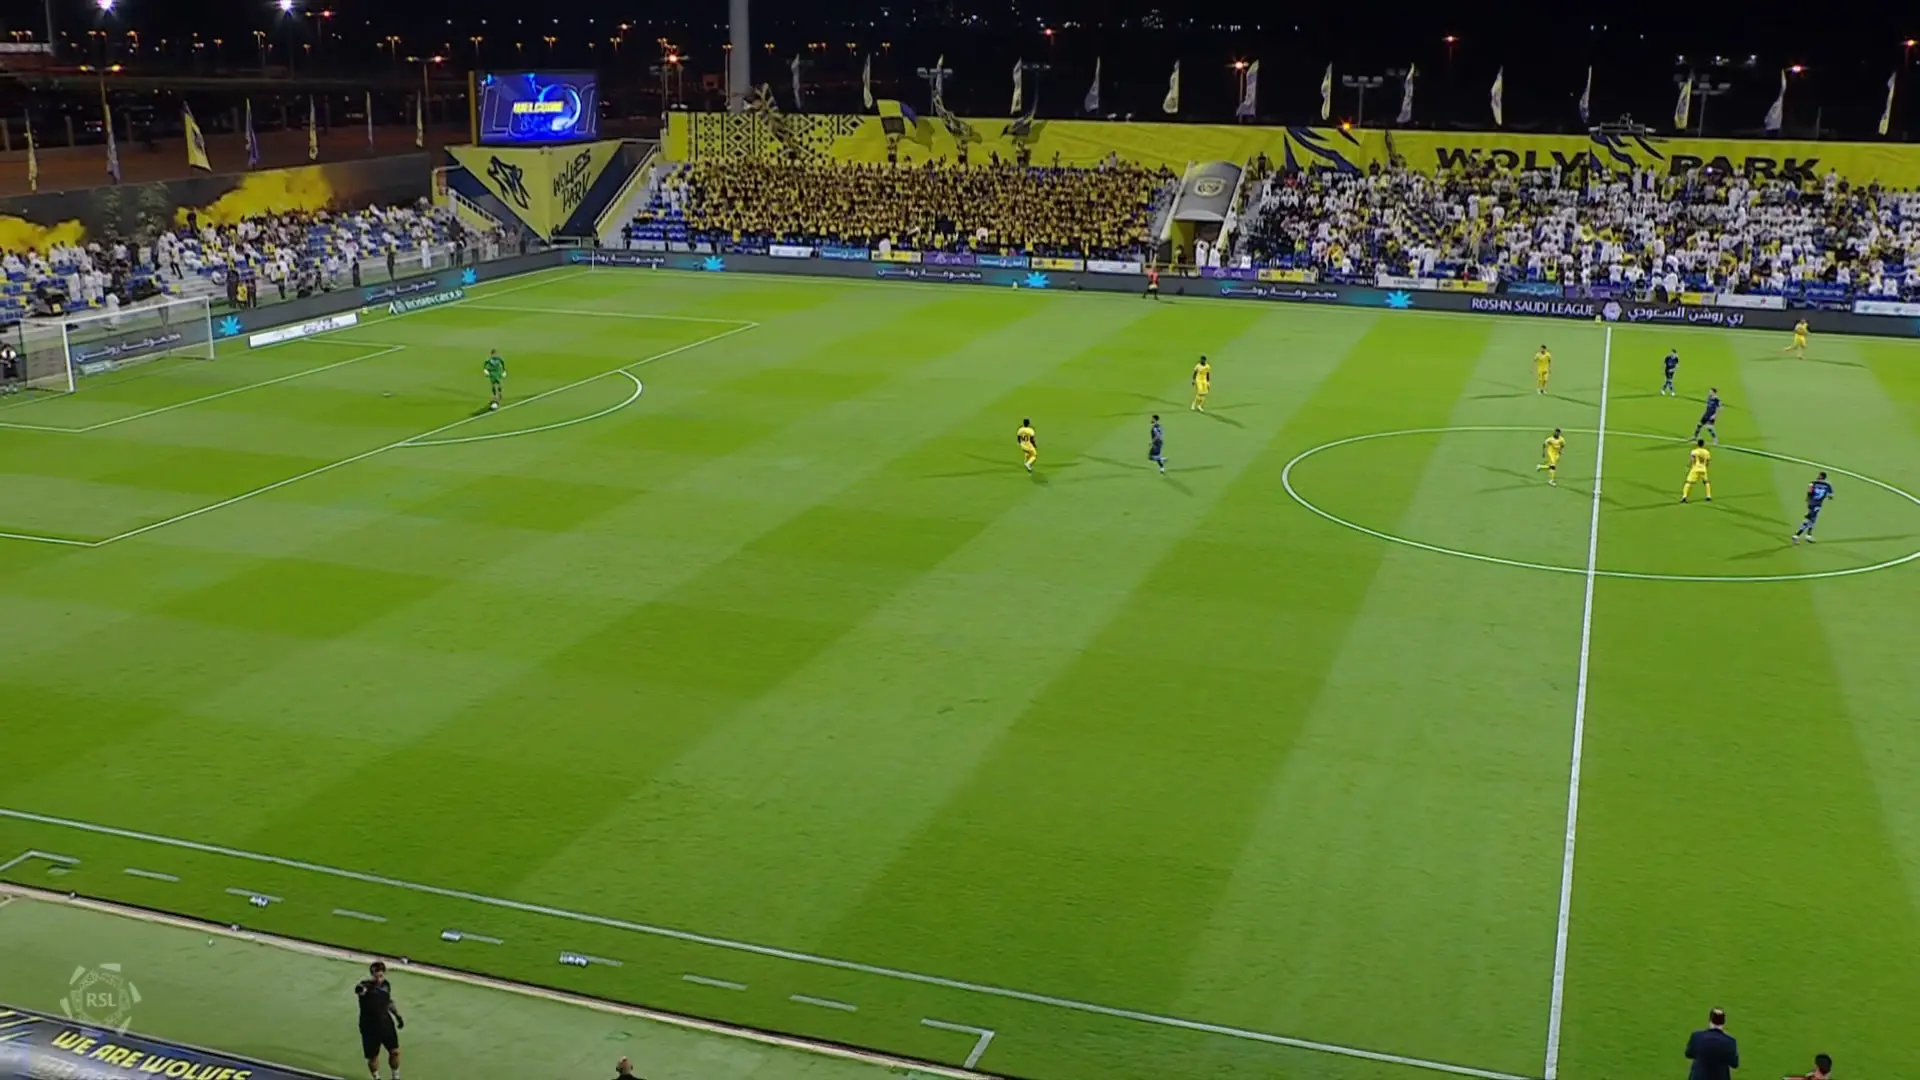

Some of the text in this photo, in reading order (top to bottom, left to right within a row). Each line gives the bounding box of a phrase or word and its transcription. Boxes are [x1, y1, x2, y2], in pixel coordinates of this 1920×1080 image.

[513, 101, 564, 113] WELCOME
[553, 148, 591, 197] WOLVES
[1669, 154, 1821, 182] PARK
[562, 171, 591, 213] PARK
[1472, 297, 1595, 317] ROSHN SAUDI LEAGUE
[1627, 306, 1744, 328] ري روشن السعودي
[51, 1031, 98, 1055] WE
[88, 1044, 145, 1069] ARE
